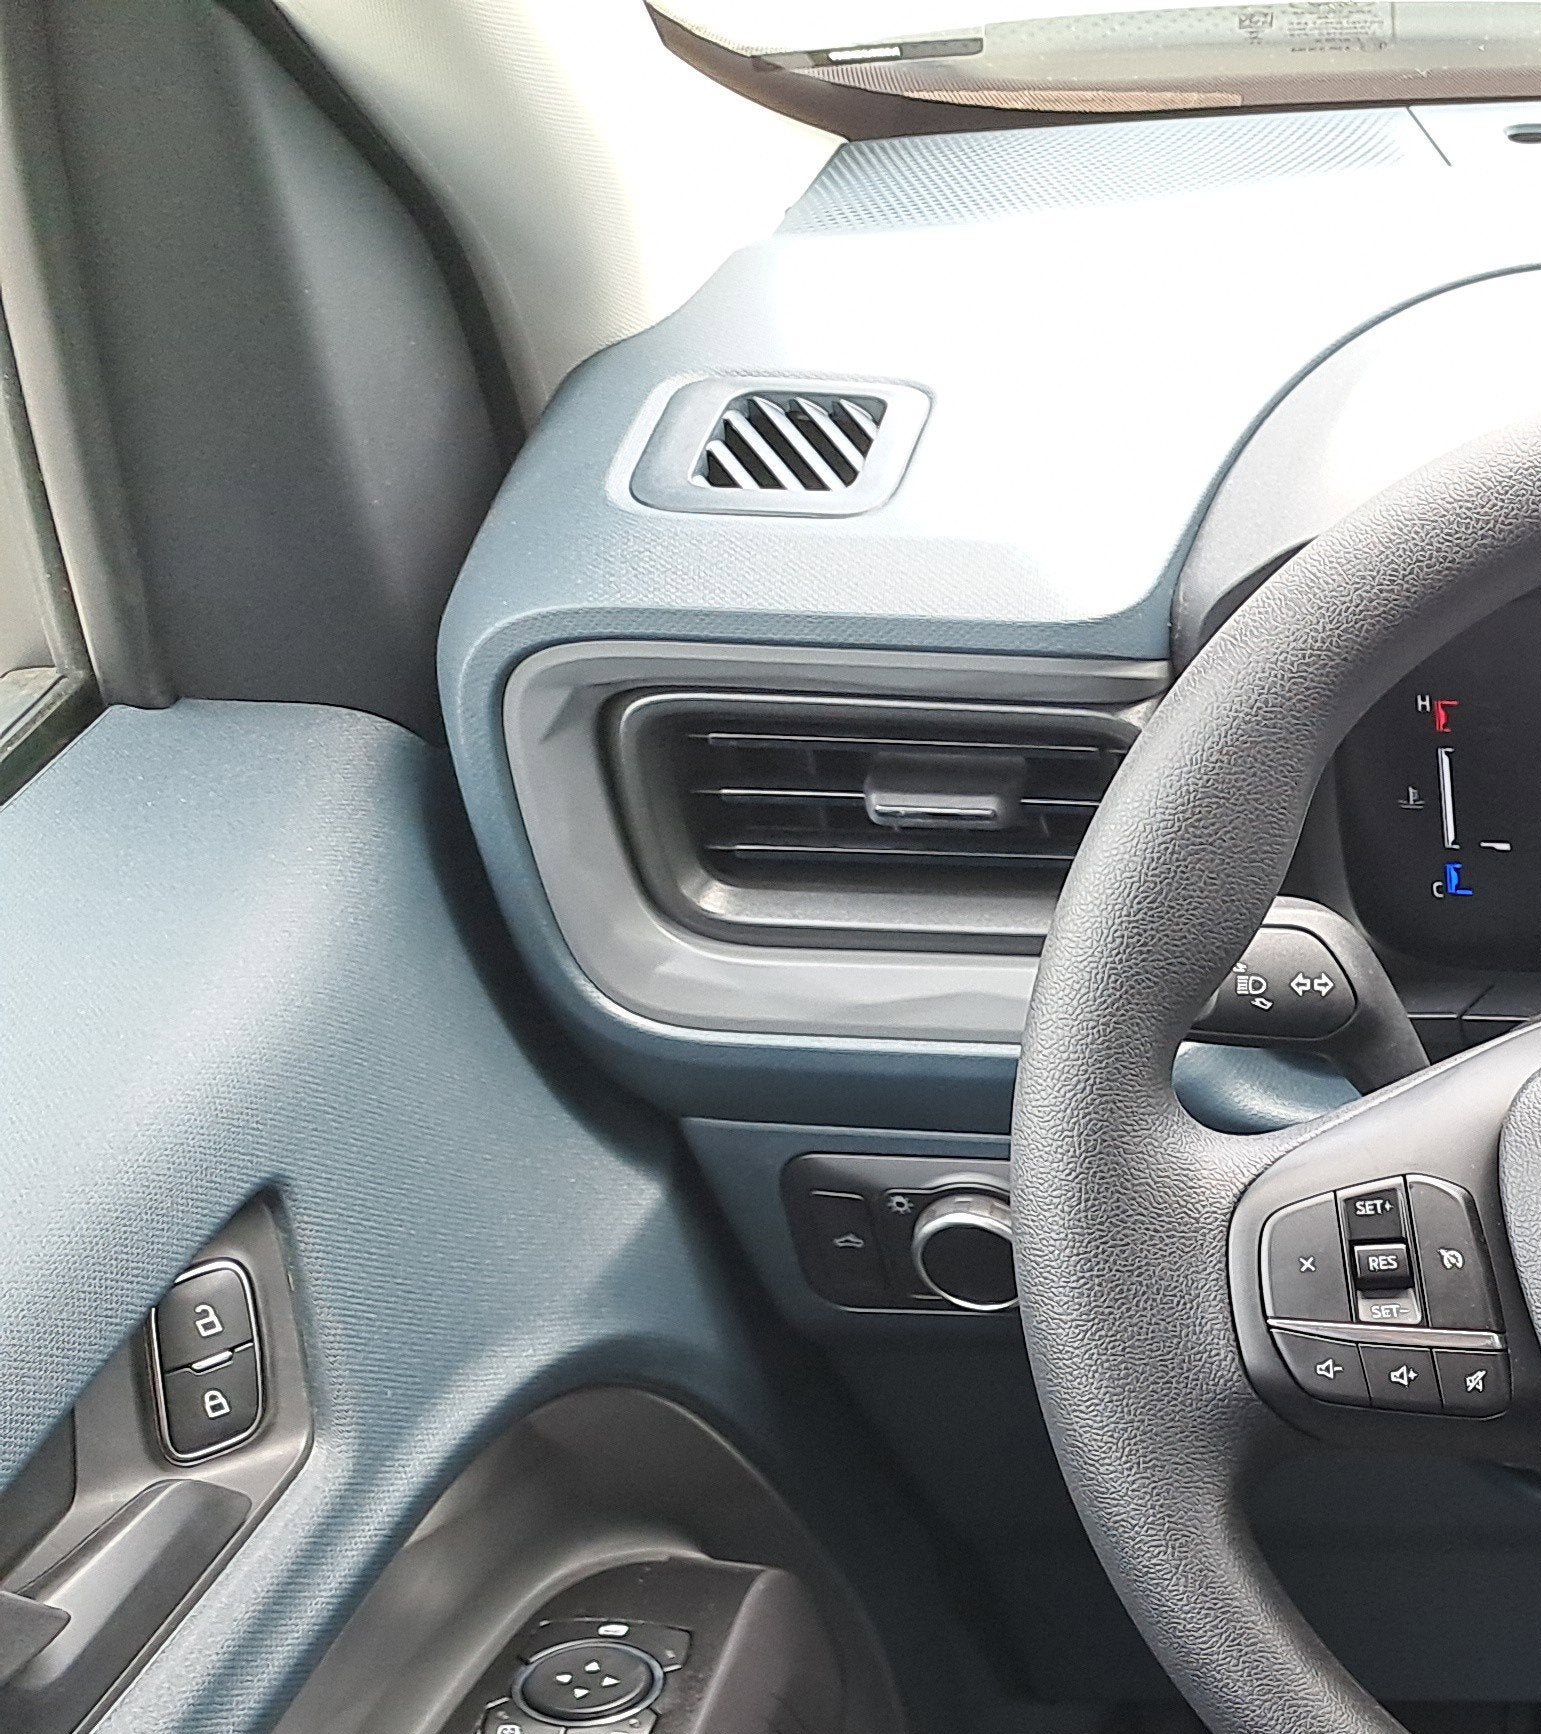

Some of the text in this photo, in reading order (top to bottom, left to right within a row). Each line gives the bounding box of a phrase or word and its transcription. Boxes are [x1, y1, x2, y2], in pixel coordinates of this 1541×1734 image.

[1417, 696, 1431, 711] H
[1433, 881, 1444, 898] C
[1368, 1256, 1398, 1271] RES
